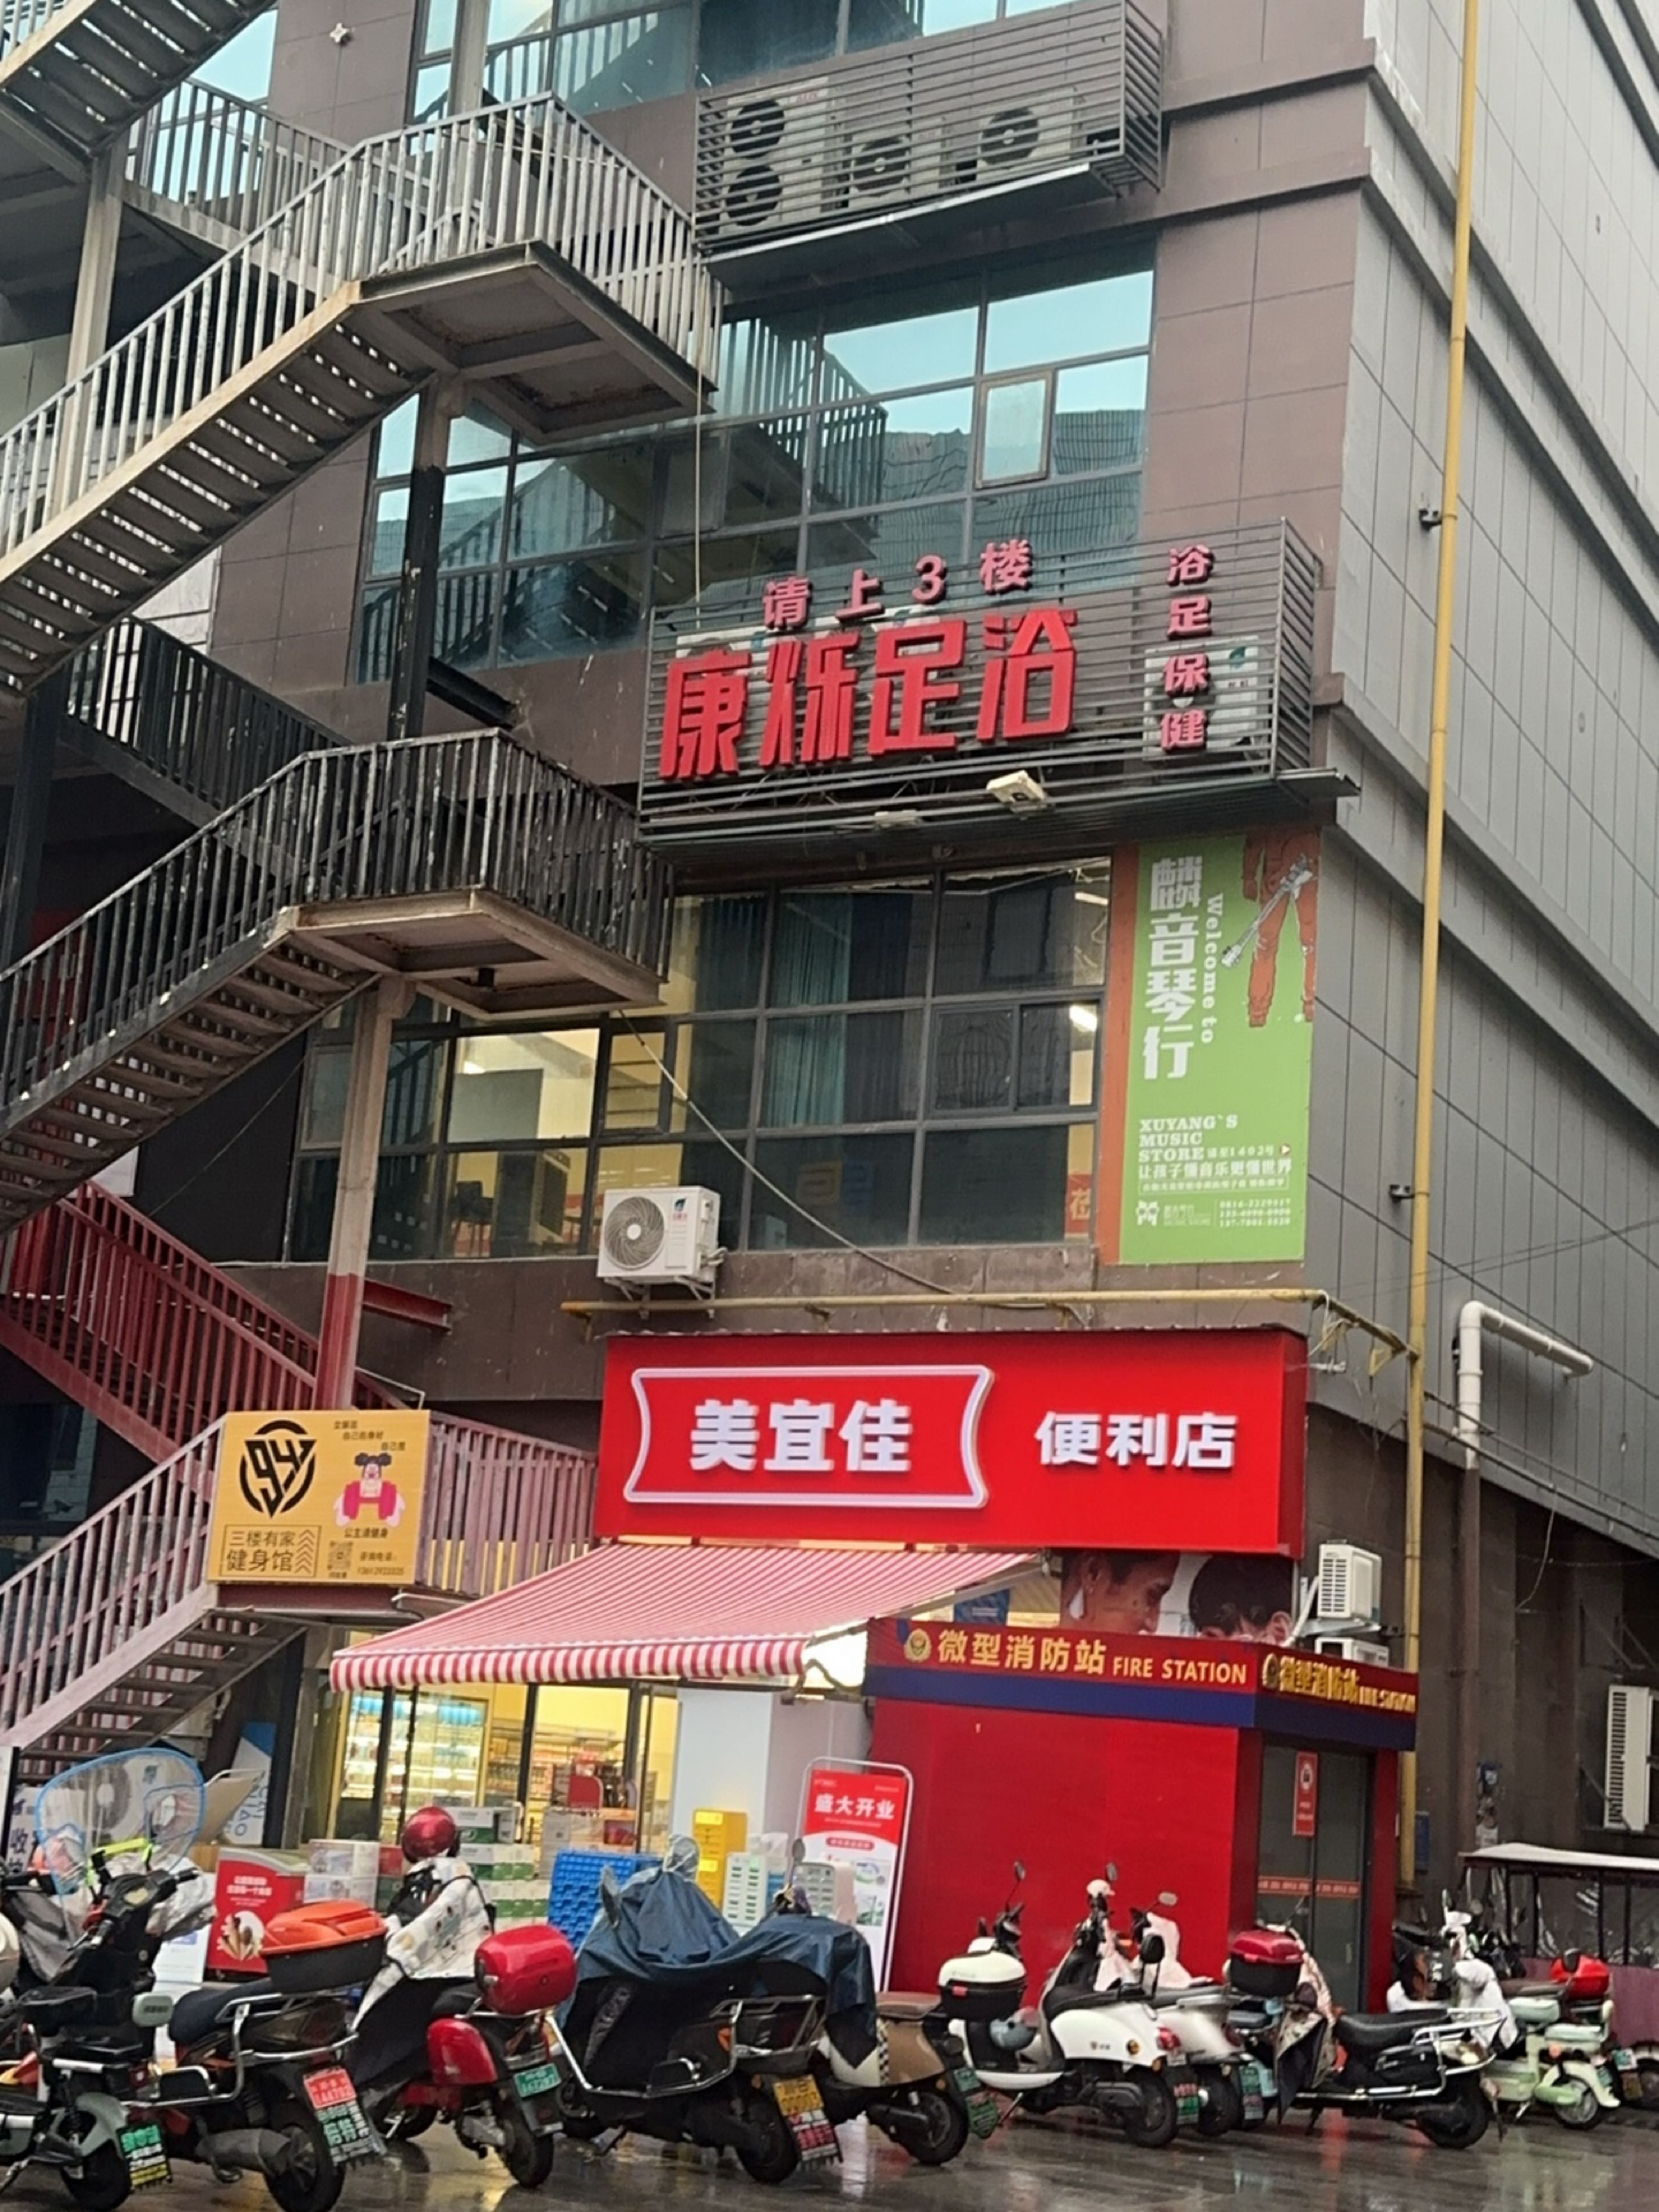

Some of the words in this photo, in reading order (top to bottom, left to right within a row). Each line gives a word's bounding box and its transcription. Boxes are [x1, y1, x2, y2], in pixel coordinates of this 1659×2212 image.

[762, 539, 1032, 629] 请上3楼
[1203, 894, 1223, 1009] Welcome
[1201, 1016, 1217, 1044] to
[1139, 1132, 1203, 1148] MUSIC
[1139, 1147, 1205, 1163] STORE
[689, 1399, 913, 1473] 美宜佳
[1035, 1411, 1238, 1470] 便利店
[228, 1530, 296, 1548] 三楼有家
[225, 1548, 295, 1573] 健身馆
[938, 1630, 1107, 1676] 微型消防站
[1113, 1656, 1153, 1679] FIRE
[1161, 1658, 1247, 1686] STATION
[813, 1793, 896, 1820] 盛大开业
